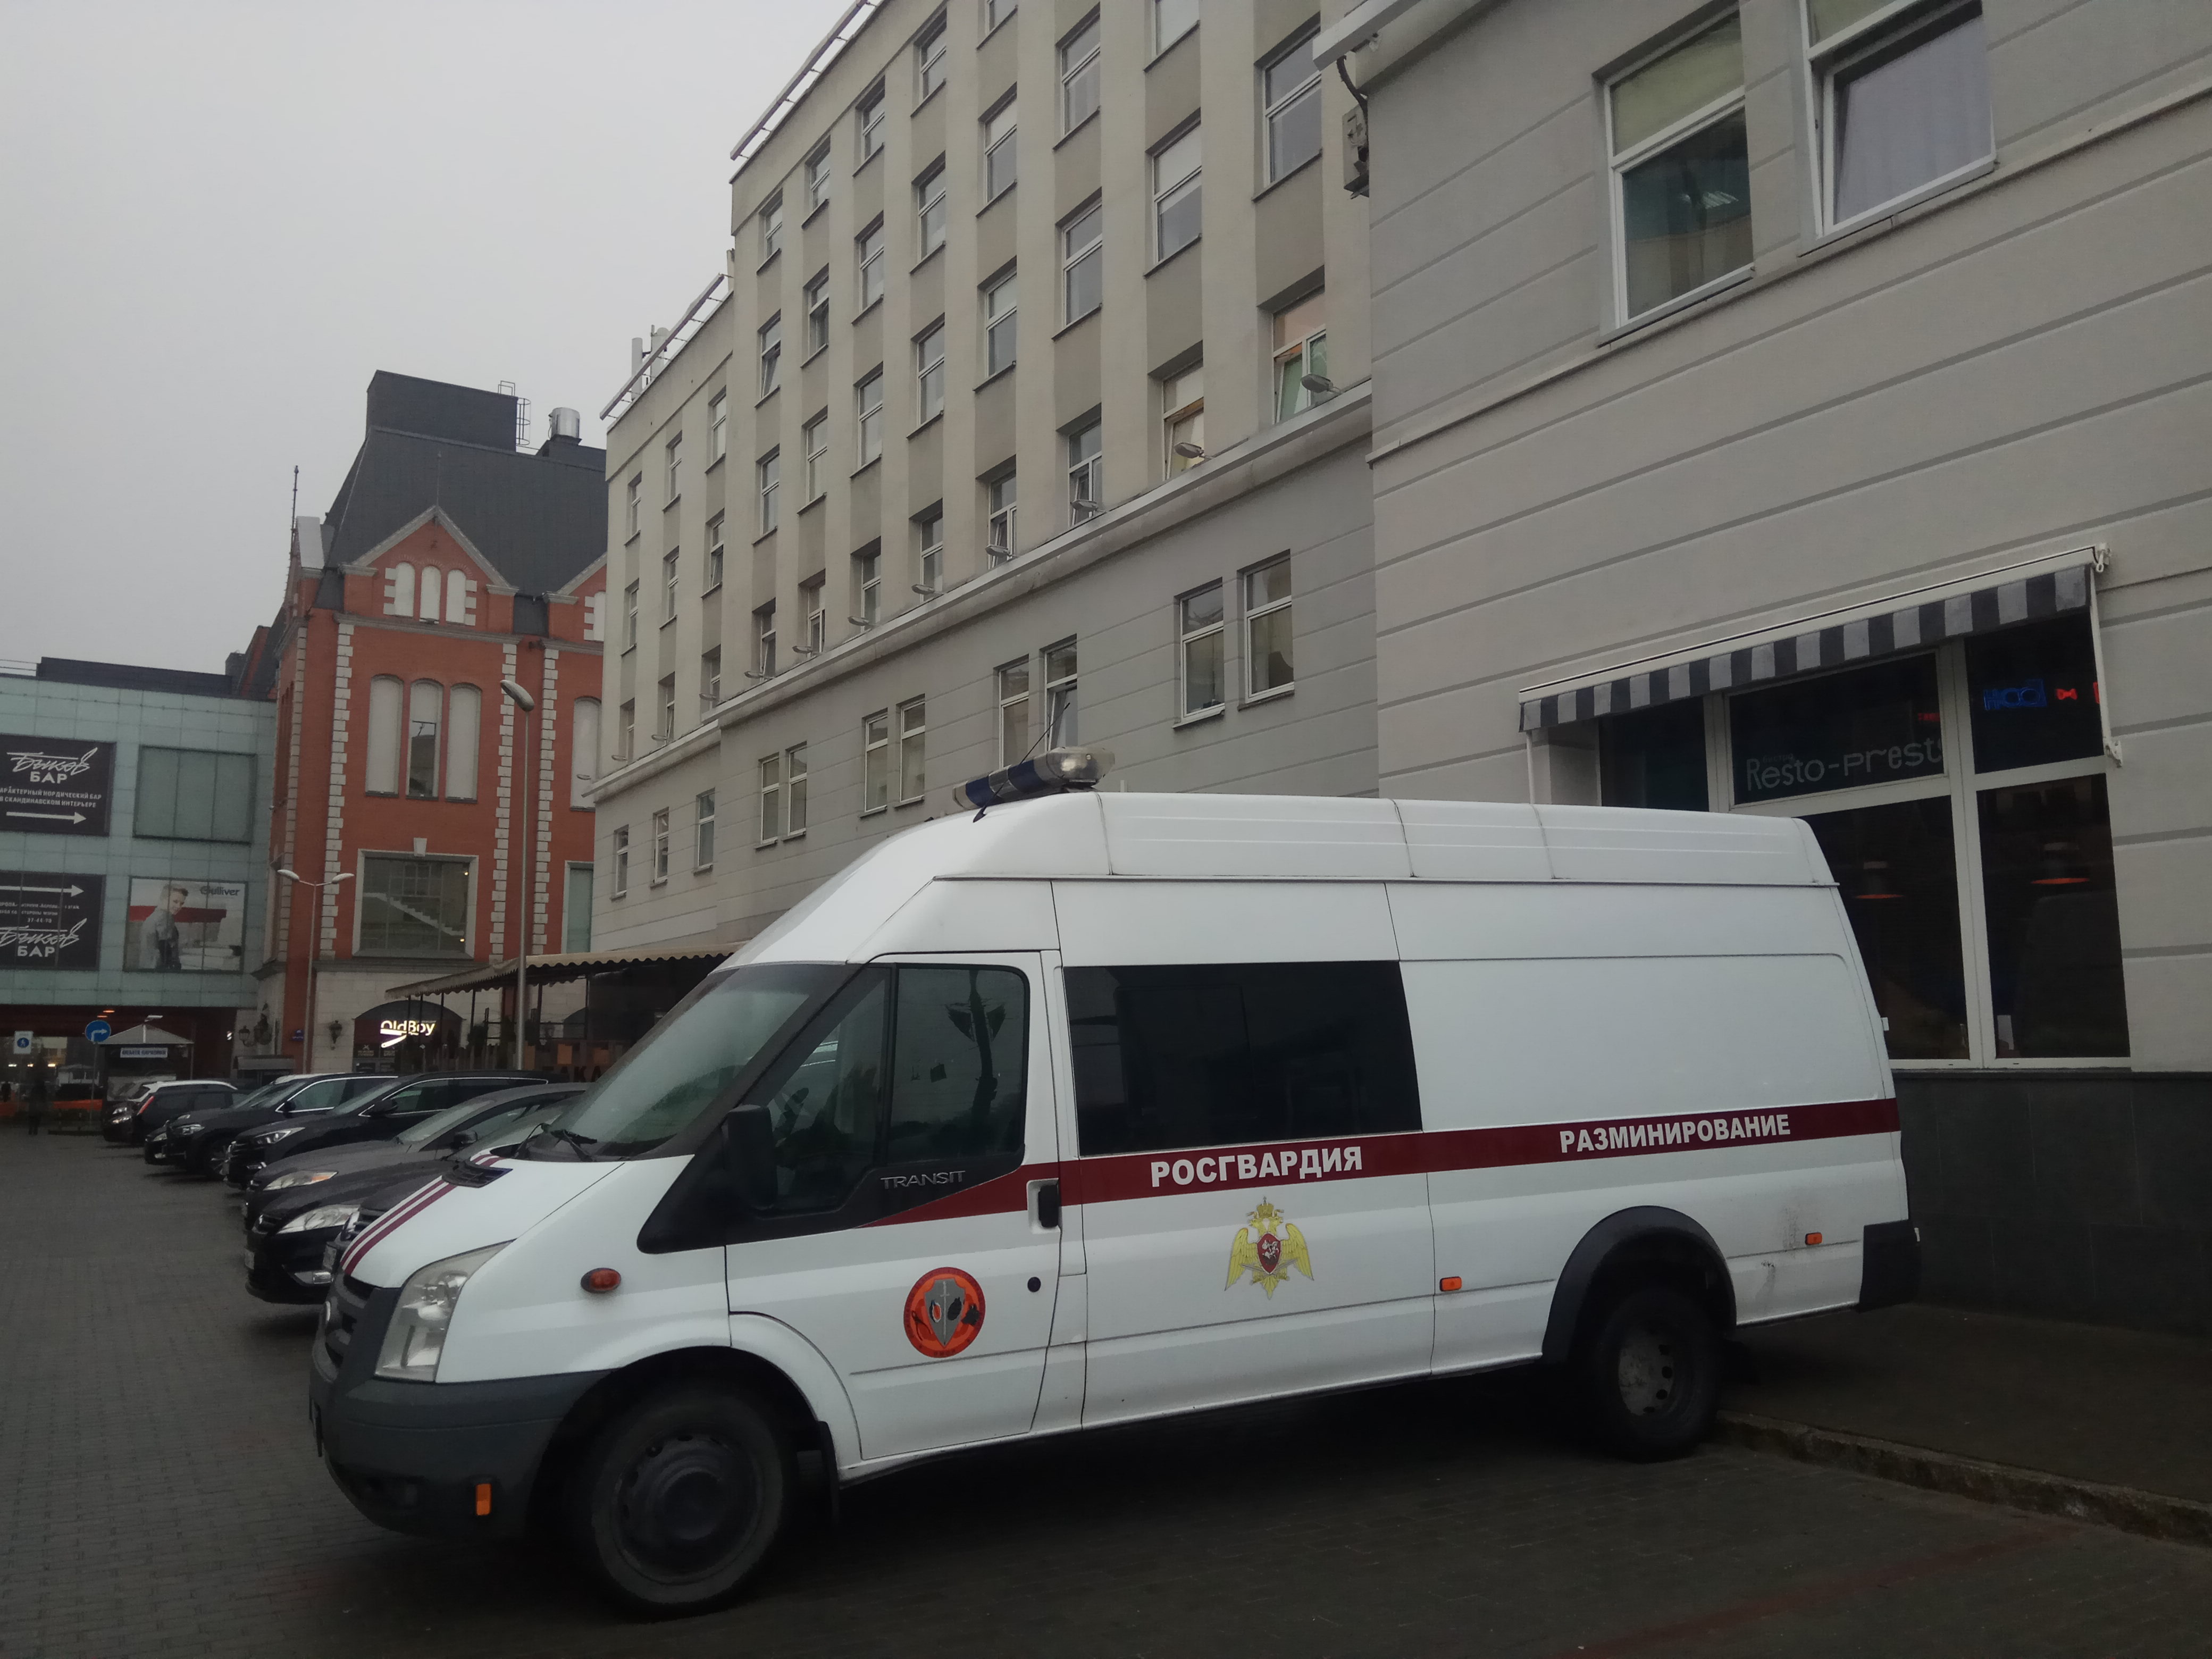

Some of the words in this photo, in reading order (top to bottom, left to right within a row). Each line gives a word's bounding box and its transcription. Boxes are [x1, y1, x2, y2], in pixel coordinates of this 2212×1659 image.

[30, 771, 68, 784] БАР
[4, 797, 61, 806] СКАНДИНАВСКОМ
[43, 791, 89, 799] НОРДИЧЕСКИЙ
[200, 885, 240, 896] Gulliver
[17, 945, 55, 957] БАР
[381, 1020, 436, 1036] OldBoy
[1560, 1115, 1790, 1153] РАЗМИНИРОВАНИЕ
[1151, 1146, 1362, 1187] РОСГВАРДИЯ
[880, 1170, 966, 1189] TRANSIT
